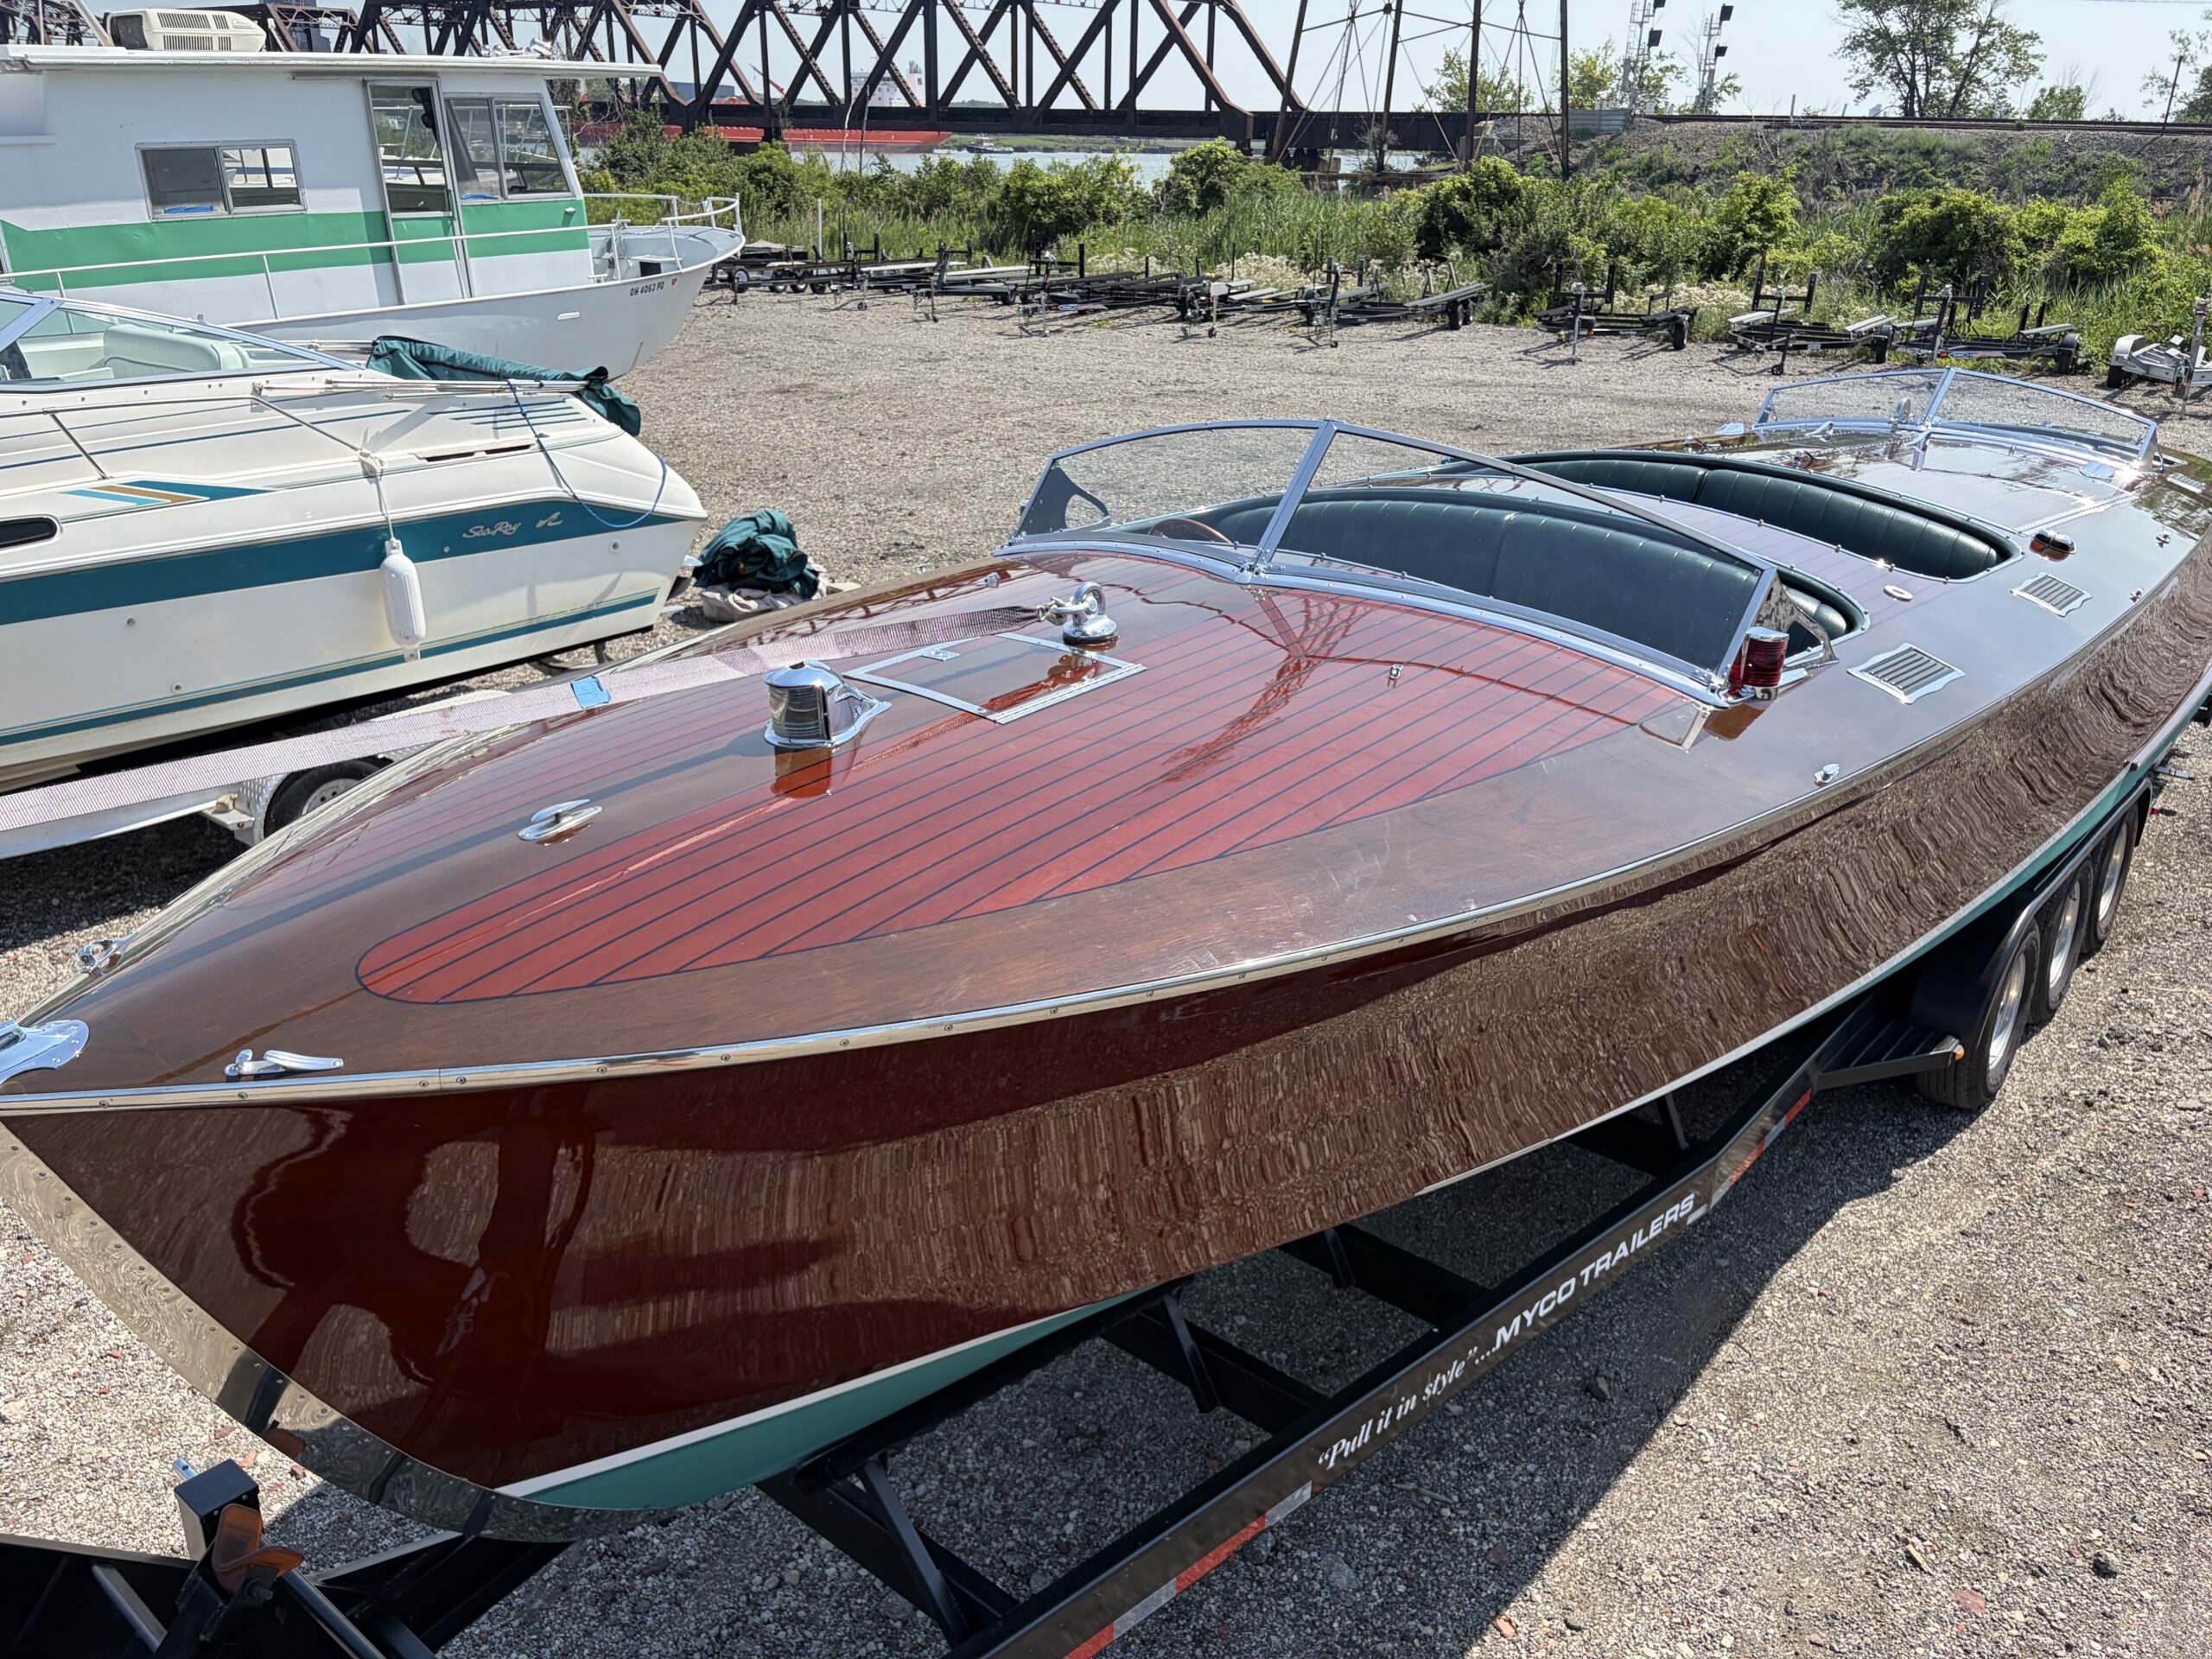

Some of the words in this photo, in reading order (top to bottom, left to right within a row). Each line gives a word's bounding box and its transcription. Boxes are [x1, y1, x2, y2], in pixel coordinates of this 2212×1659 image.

[630, 287, 639, 296] OH
[639, 283, 656, 294] 4063
[1376, 1406, 1393, 1434] it
[1396, 1394, 1417, 1421] in
[1580, 1192, 1695, 1287] TRAILERS
